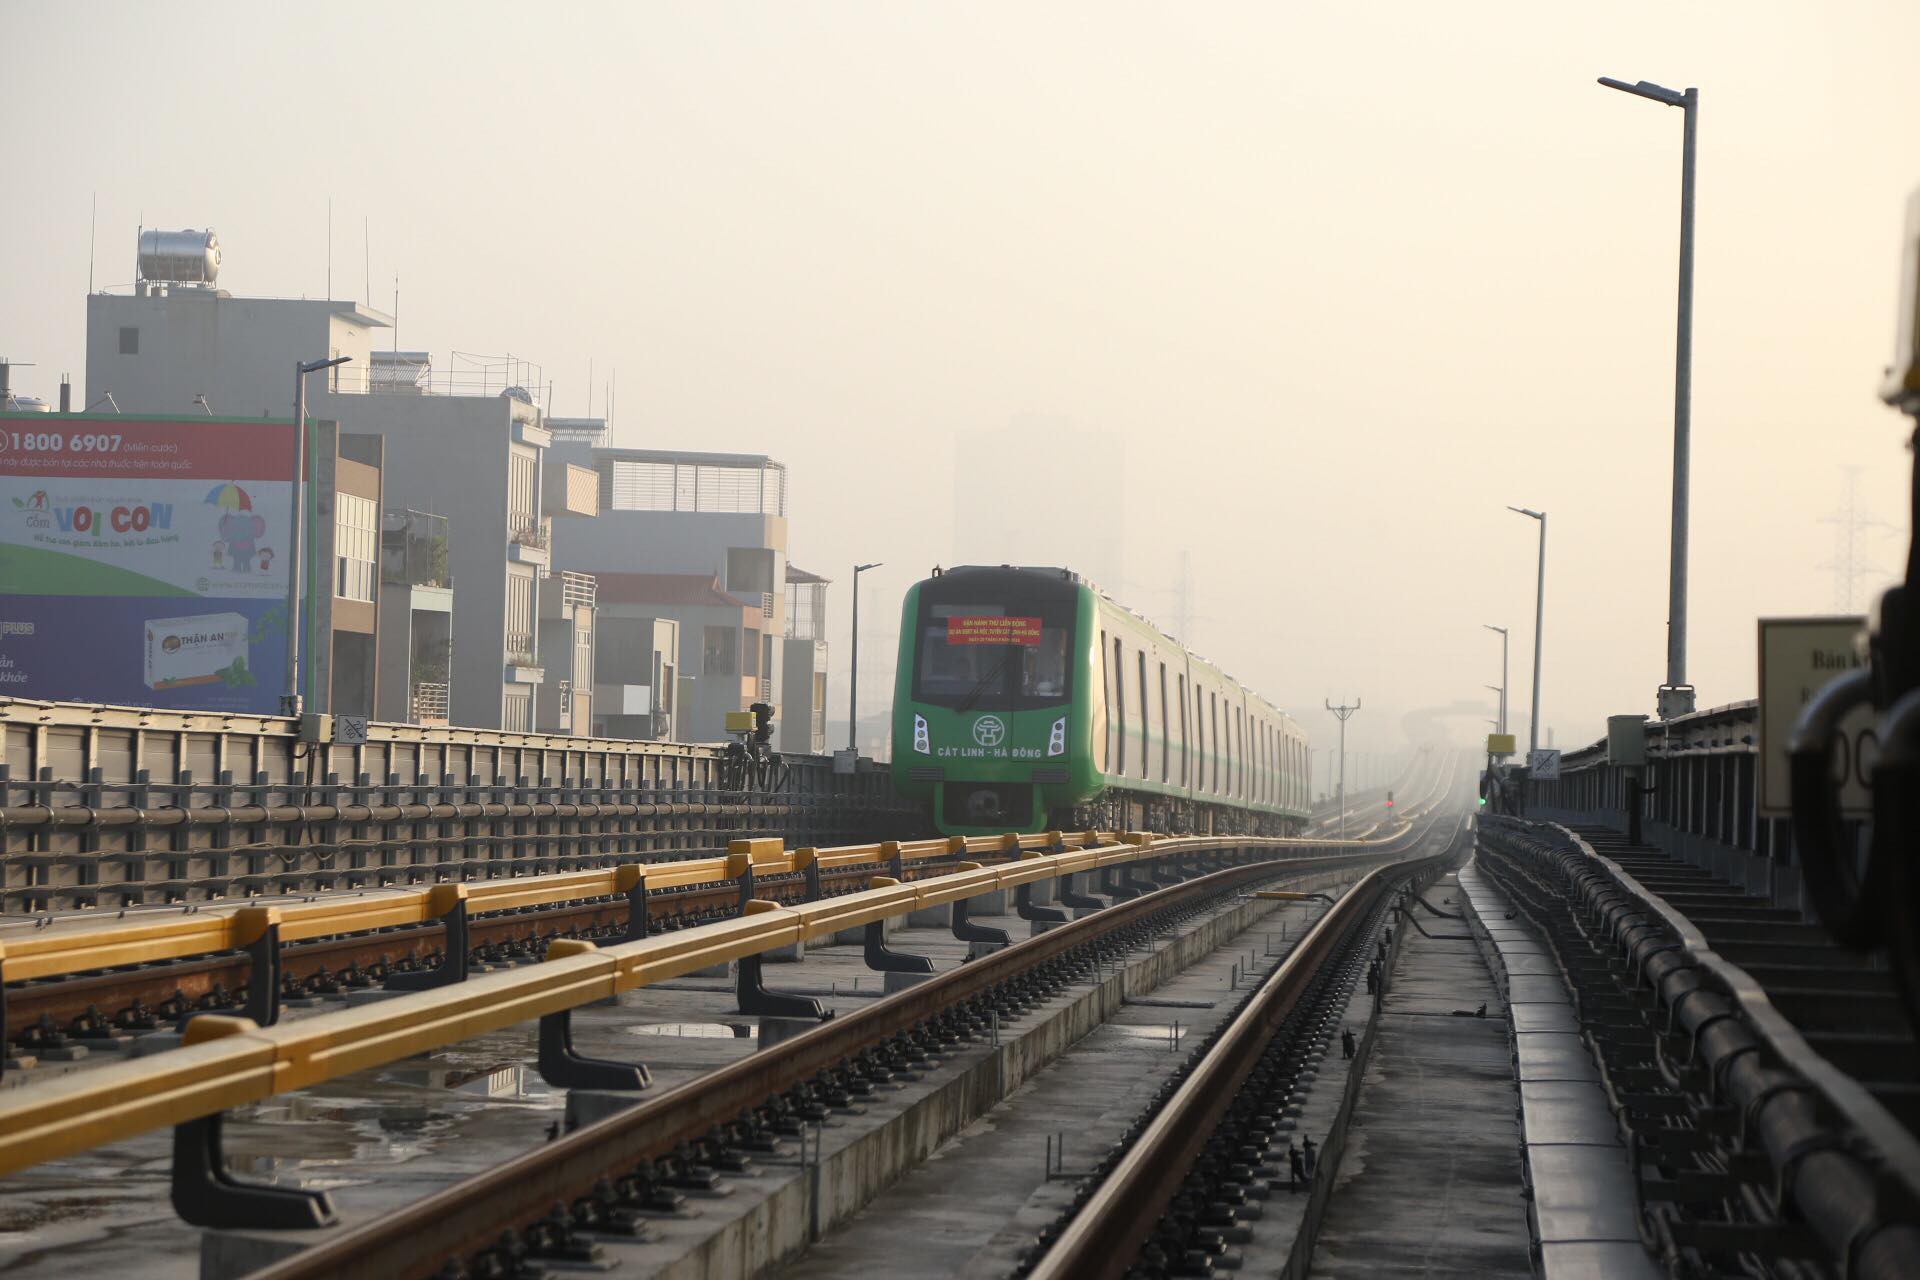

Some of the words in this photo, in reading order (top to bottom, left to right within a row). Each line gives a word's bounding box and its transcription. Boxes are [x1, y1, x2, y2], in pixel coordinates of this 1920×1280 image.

[11, 432, 62, 452] 1800
[70, 433, 121, 453] 6907
[54, 506, 101, 536] VOI
[111, 502, 174, 533] CON
[4, 624, 33, 634] PLUS
[181, 633, 207, 646] THẬN
[210, 632, 224, 641] AN
[962, 747, 985, 757] LINH
[1012, 747, 1041, 758] ĐÔNG
